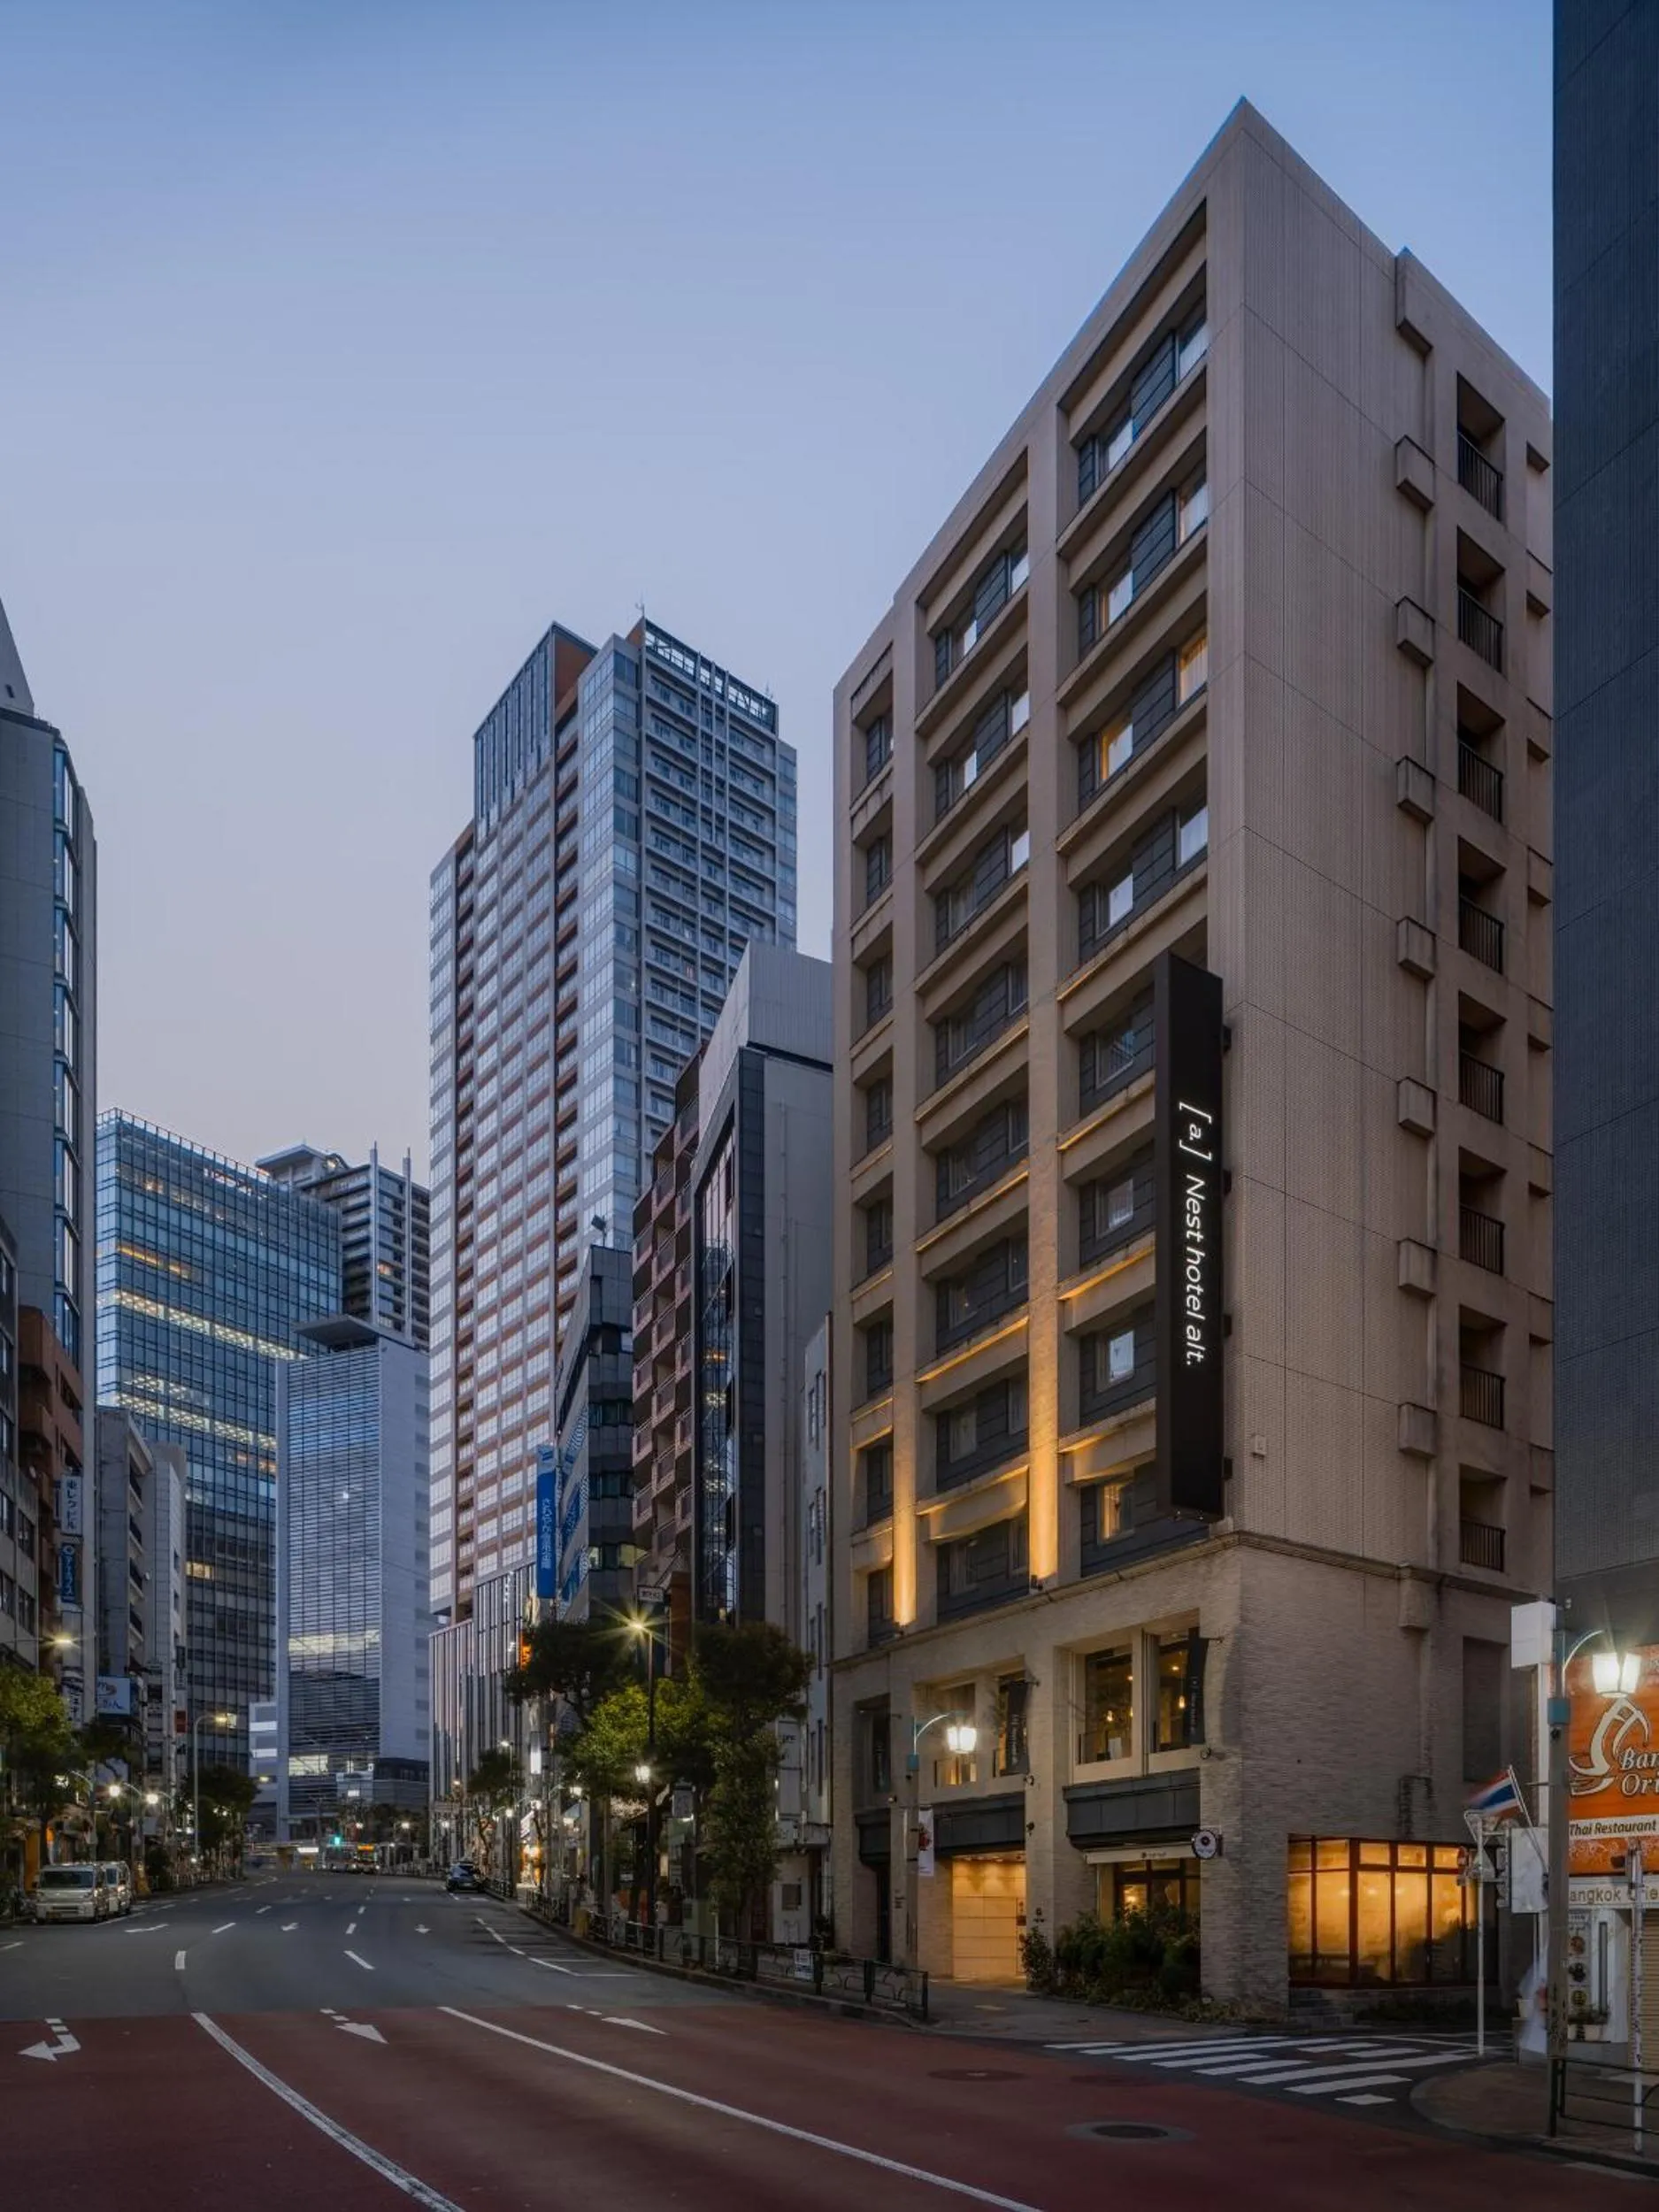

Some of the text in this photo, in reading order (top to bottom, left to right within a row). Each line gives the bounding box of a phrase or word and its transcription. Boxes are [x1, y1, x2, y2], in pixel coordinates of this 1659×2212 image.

[1186, 1174, 1206, 1242] Nest
[1186, 1246, 1206, 1320] hotel
[1186, 1325, 1206, 1365] alt.
[1570, 1820, 1657, 1836] Thai Restaurant
[1569, 1887, 1621, 1905] angkok
